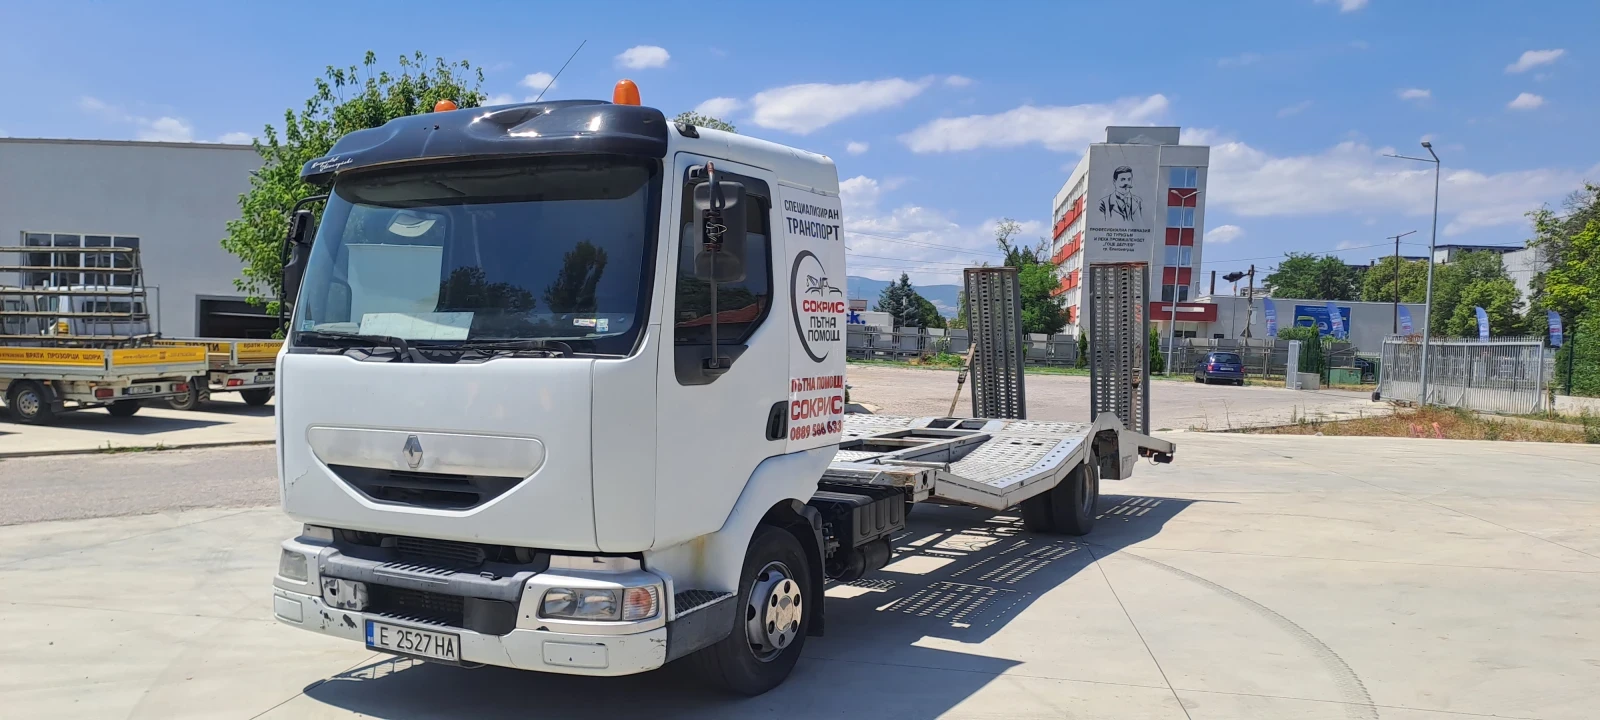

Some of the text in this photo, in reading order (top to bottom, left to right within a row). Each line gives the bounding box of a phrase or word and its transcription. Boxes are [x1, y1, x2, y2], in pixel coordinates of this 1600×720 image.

[784, 199, 840, 220] СПЕЦИАЛИЗИРАН
[786, 216, 840, 241] ТРАНСПОРТ
[802, 299, 845, 314] СОКРИС
[810, 316, 837, 329] ПЪТНА
[807, 329, 841, 342] ПОМОЩ
[791, 375, 844, 393] ПЪТНА ПОМОЩ
[791, 395, 843, 421] СОКРИС
[789, 424, 811, 441] 0889
[379, 626, 389, 646] E
[396, 629, 432, 653] 2527
[434, 635, 455, 657] HA
